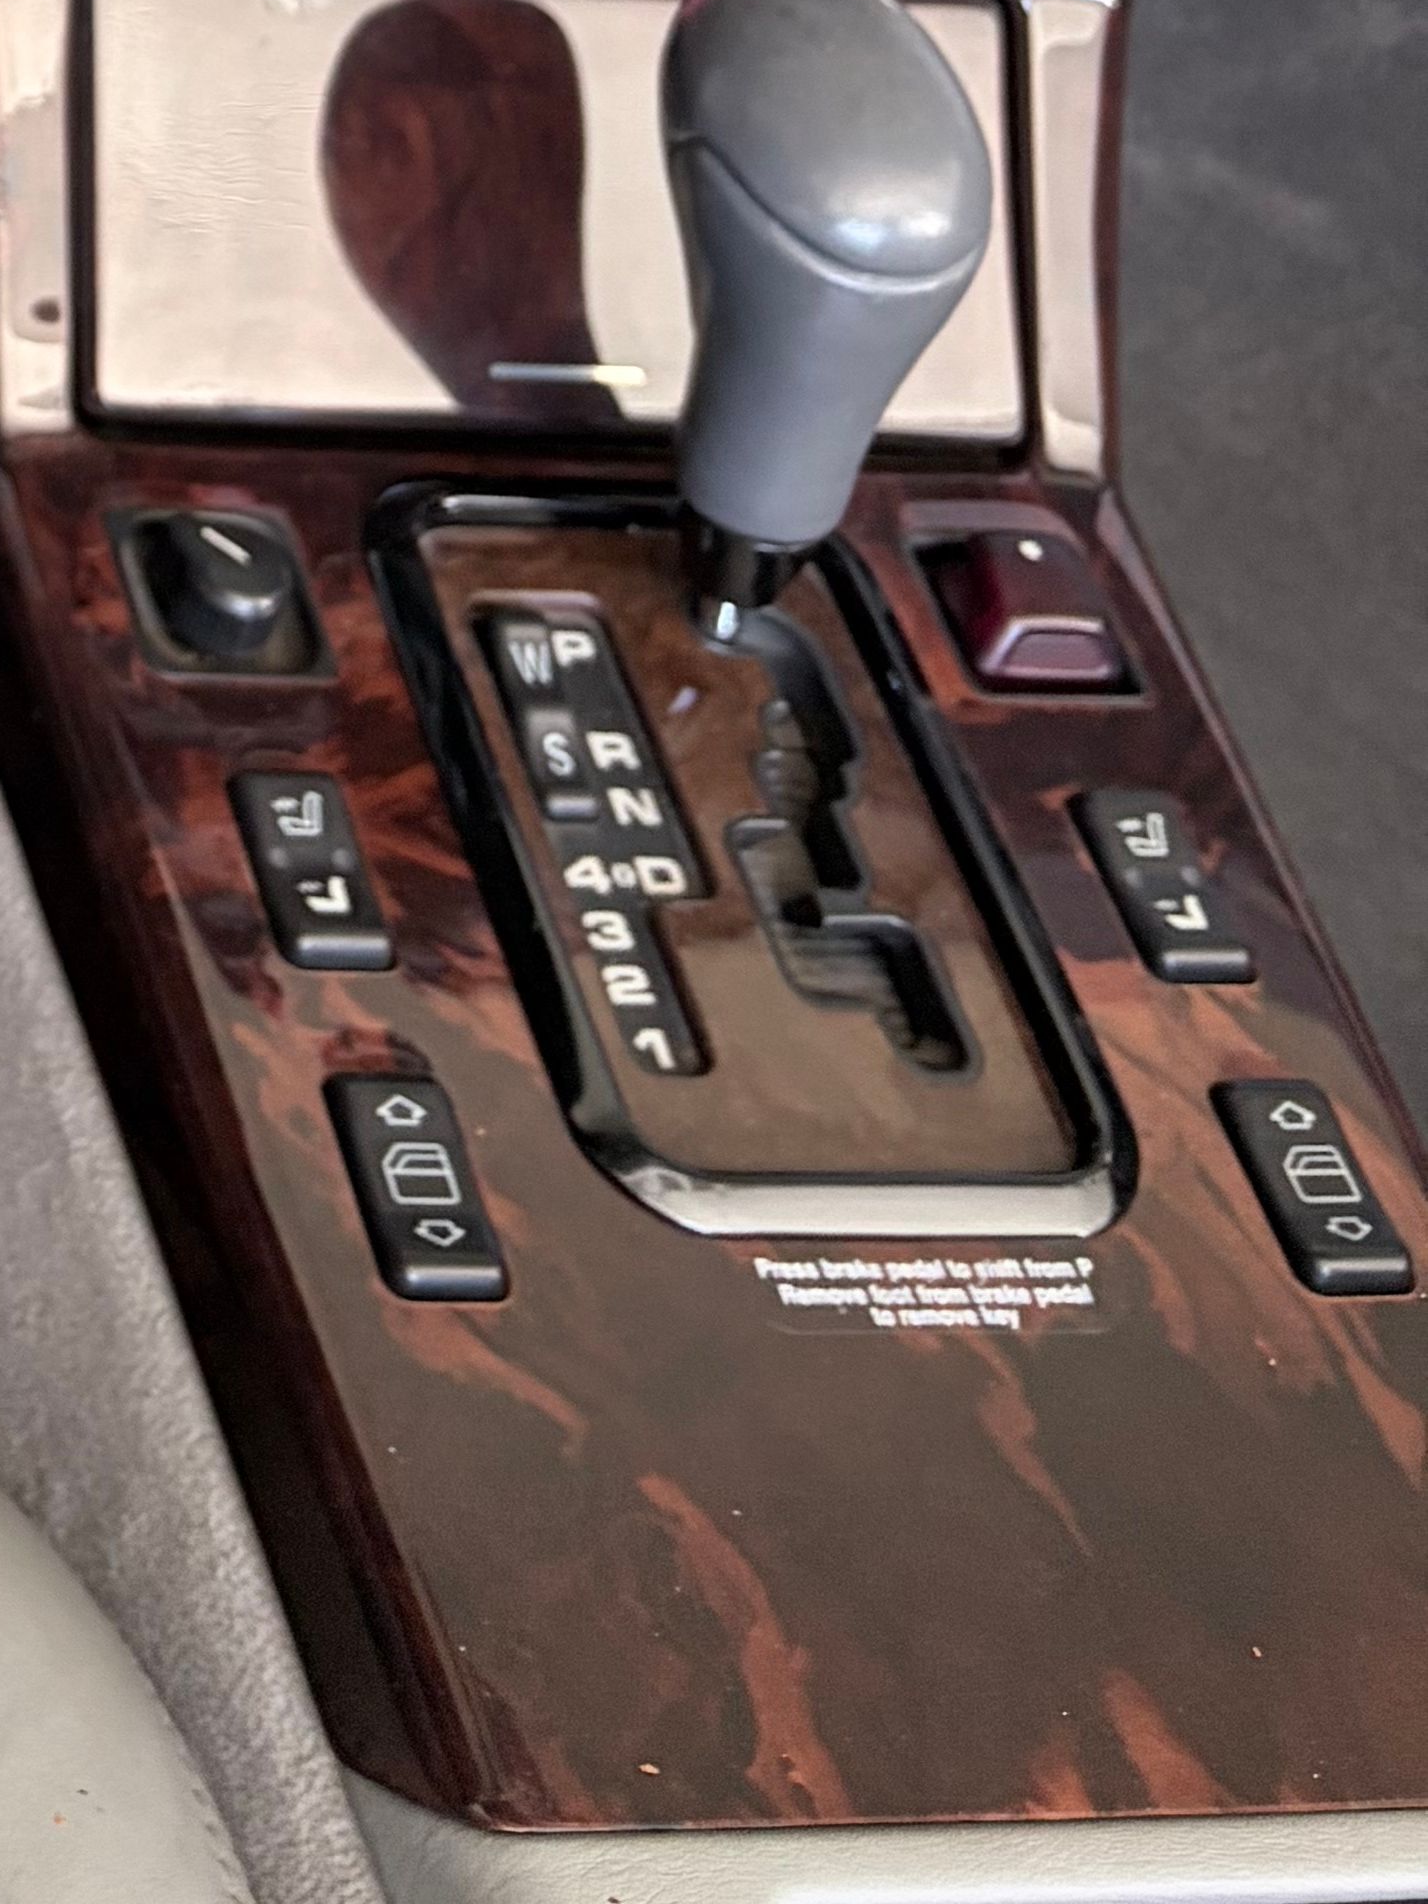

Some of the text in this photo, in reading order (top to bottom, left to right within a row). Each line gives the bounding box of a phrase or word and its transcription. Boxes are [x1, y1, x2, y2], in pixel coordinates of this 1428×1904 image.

[507, 629, 597, 686] W P
[543, 731, 641, 777] S R
[605, 786, 663, 827] N
[563, 854, 686, 894] 4 D
[582, 910, 635, 951] 3
[603, 964, 657, 1007] 2
[632, 1028, 676, 1071] 1
[754, 1257, 1094, 1284] Press brake pedal to shift from P
[777, 1284, 1095, 1308] Remove foot from brake pedal
[870, 1306, 1020, 1330] to remove key
